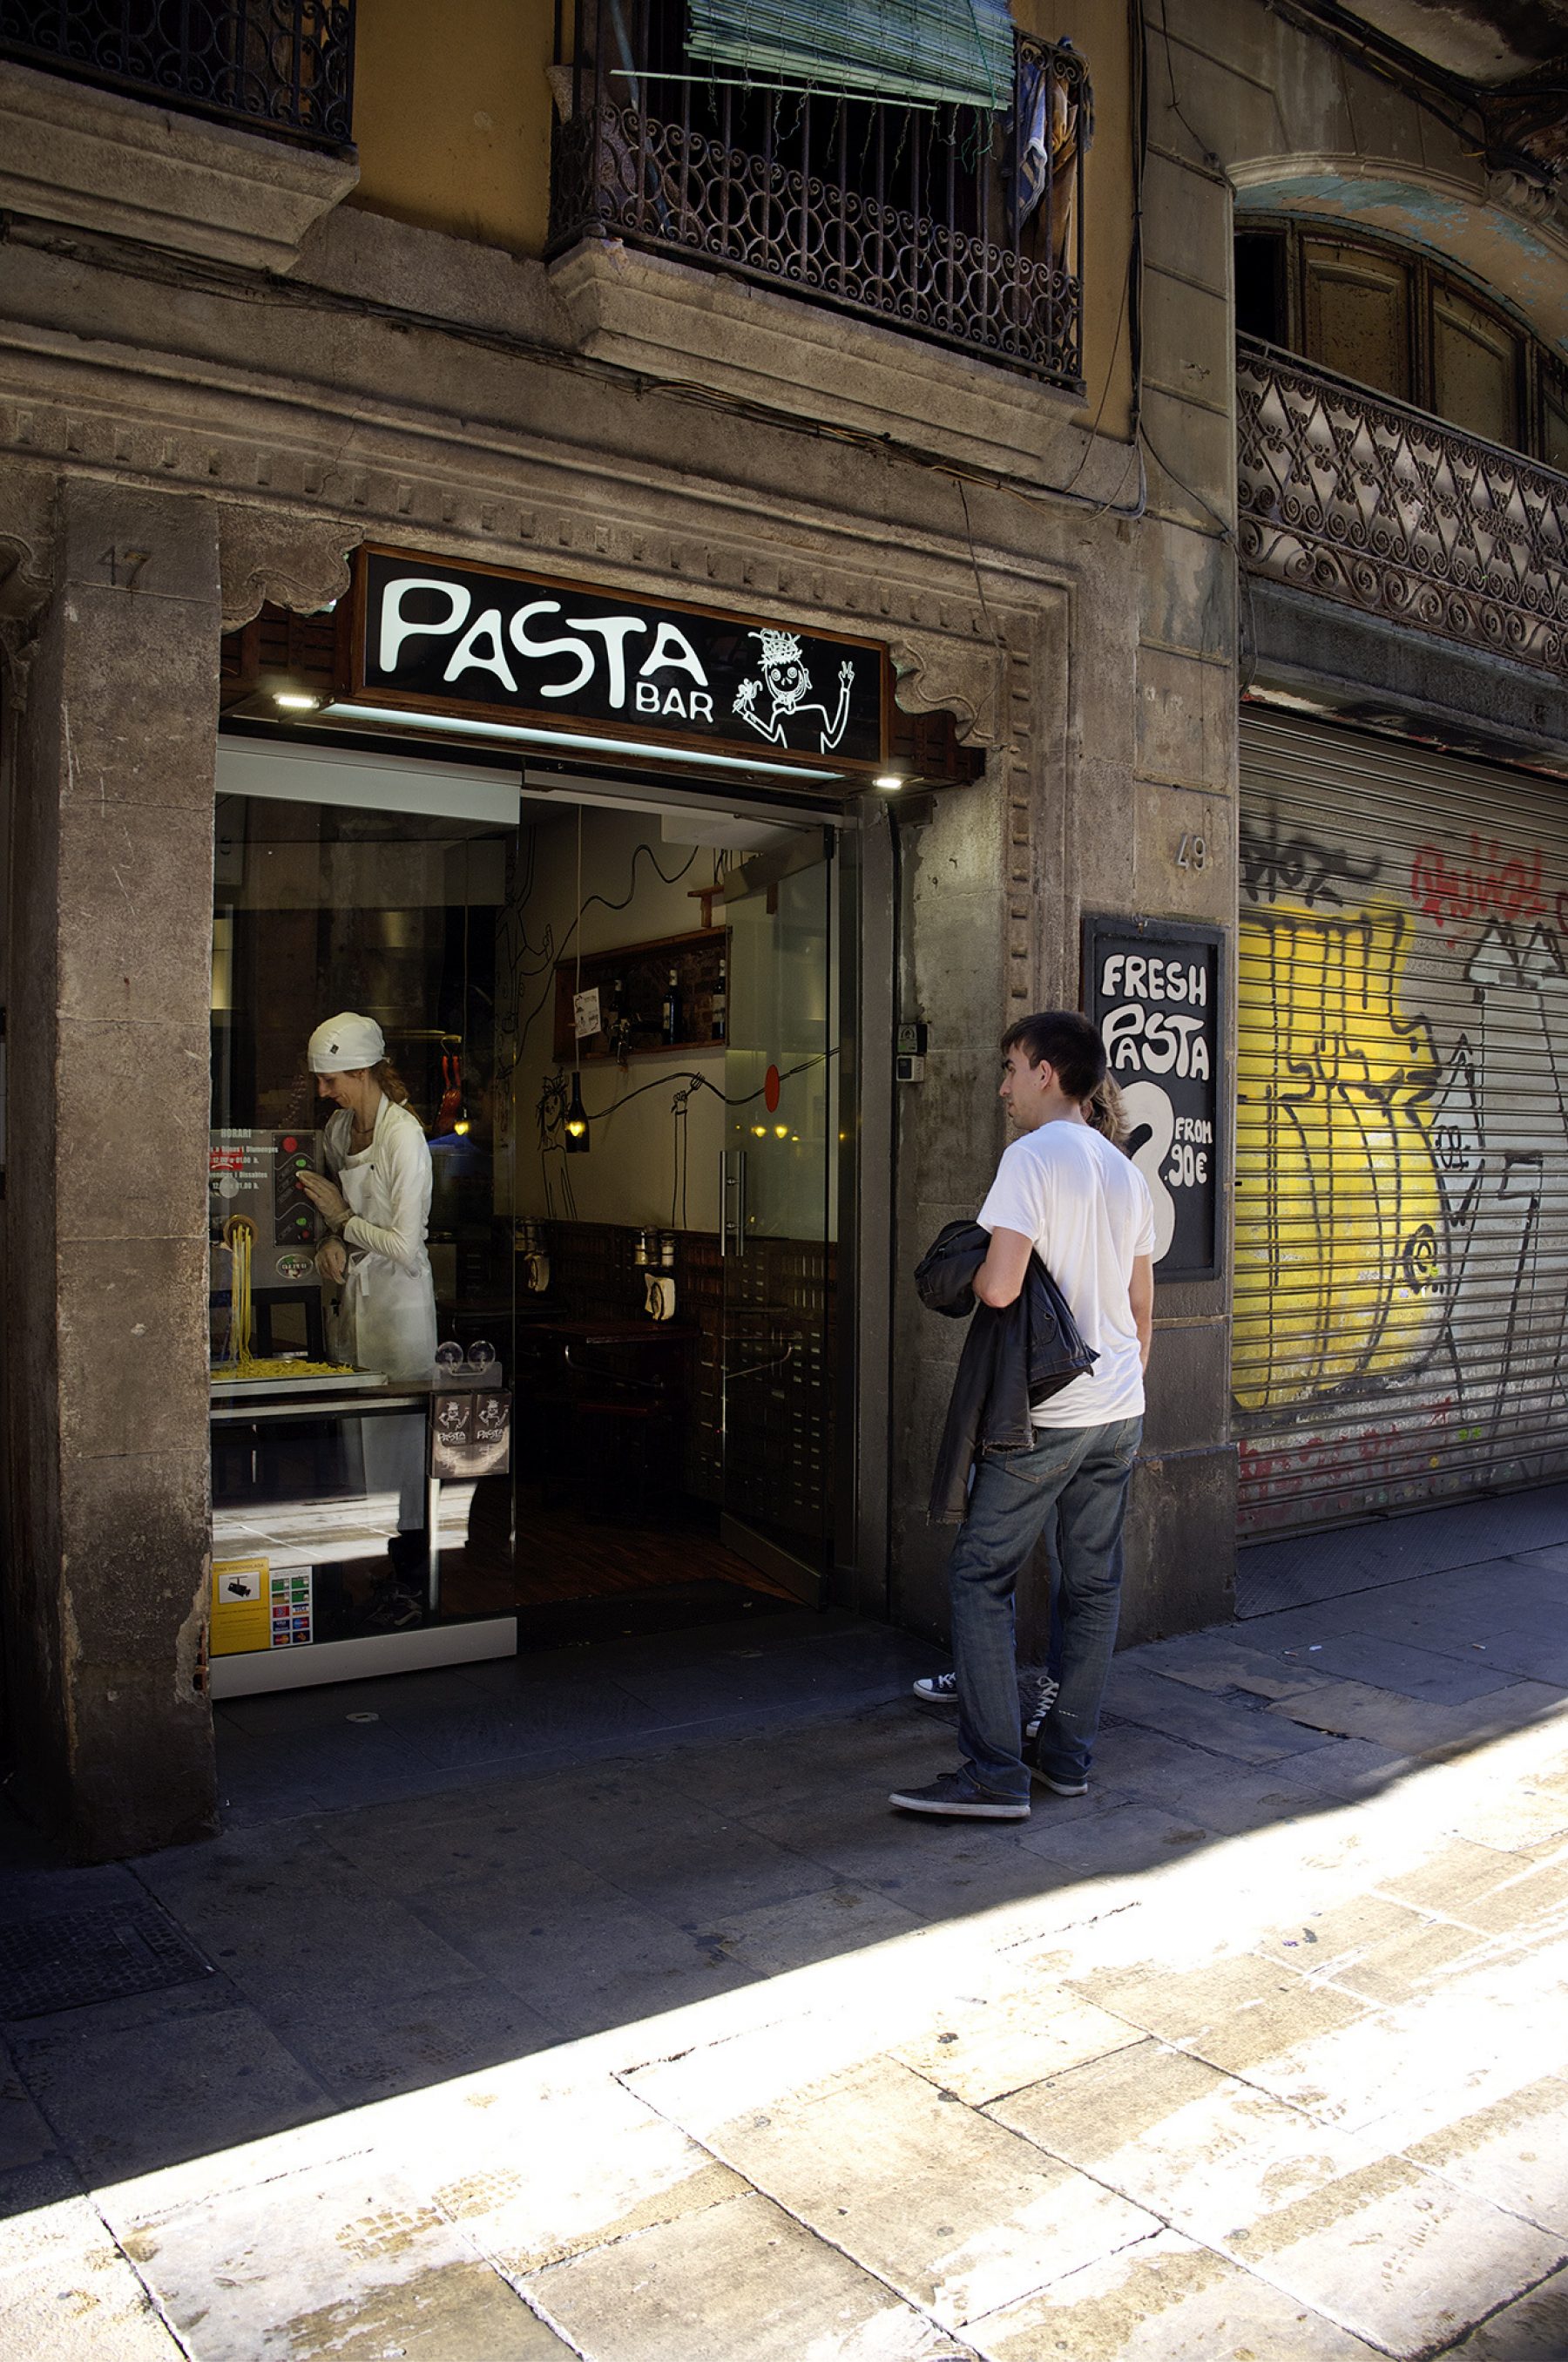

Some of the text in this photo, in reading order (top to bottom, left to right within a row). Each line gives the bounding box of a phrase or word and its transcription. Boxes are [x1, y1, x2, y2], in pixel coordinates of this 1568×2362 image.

[96, 545, 151, 588] 47
[381, 579, 707, 708] PASTA
[635, 682, 713, 723] BAR
[1175, 832, 1206, 871] 49
[1102, 954, 1206, 1007] FRESH
[1102, 1003, 1209, 1080] PASTA
[220, 1128, 252, 1139] HORARI
[1175, 1116, 1213, 1143] FROM
